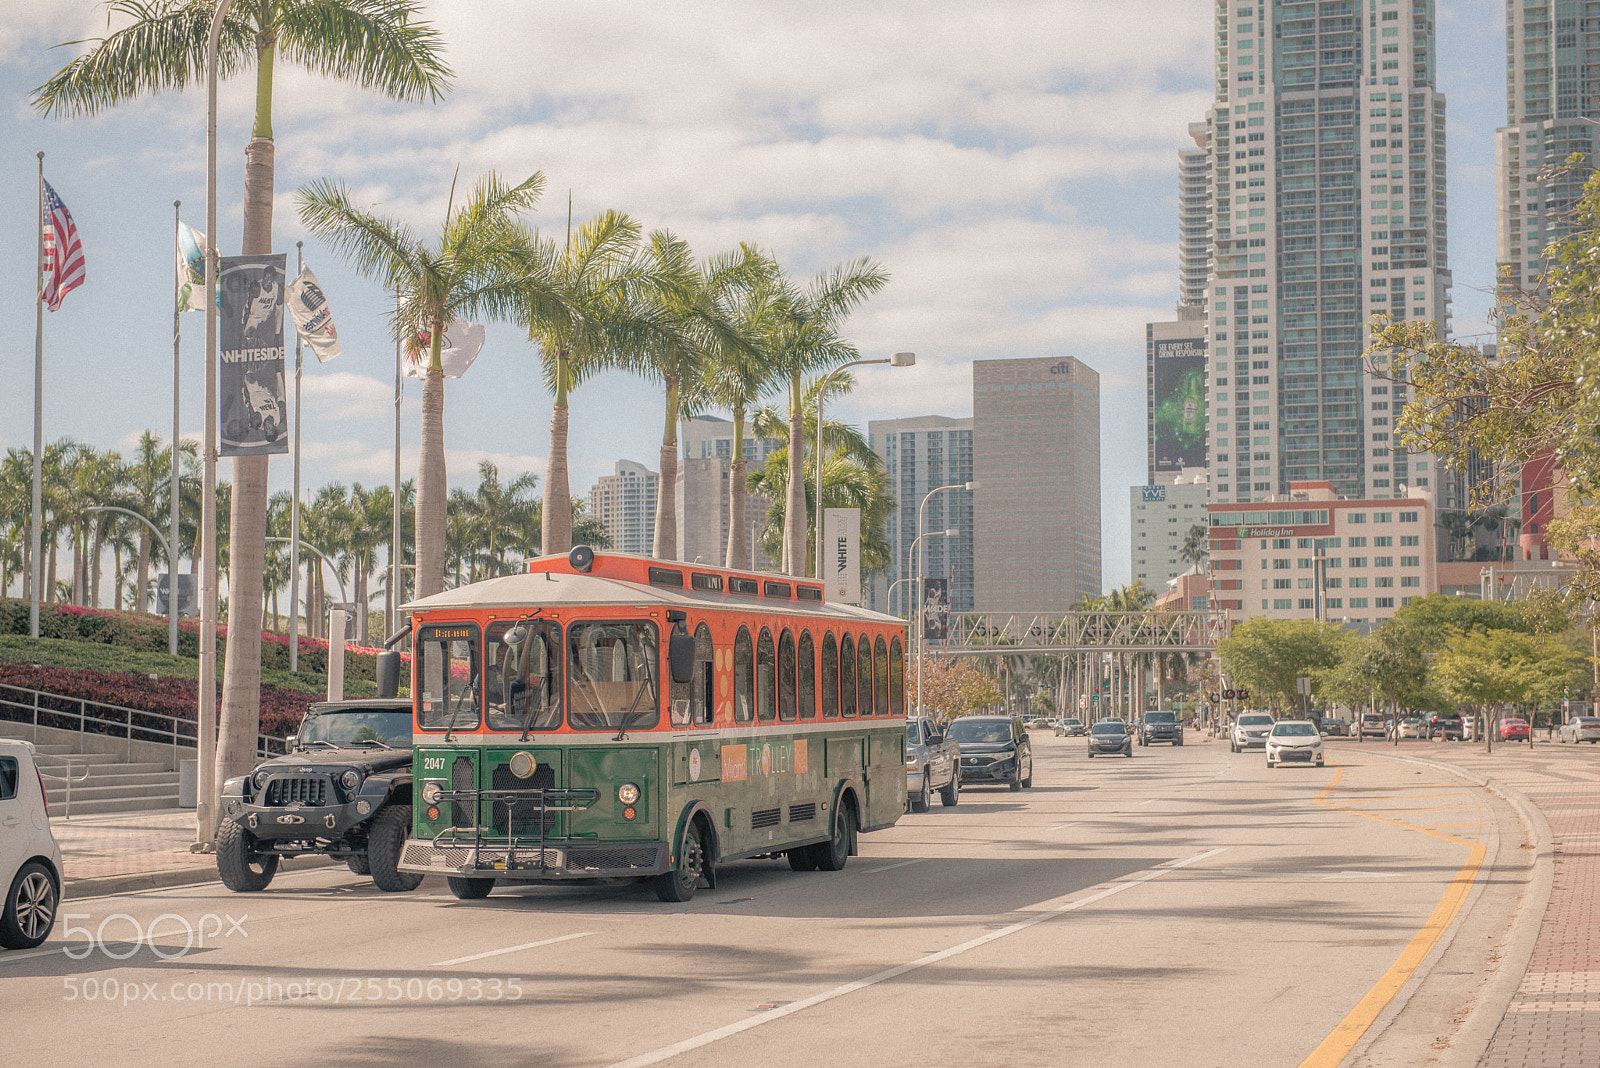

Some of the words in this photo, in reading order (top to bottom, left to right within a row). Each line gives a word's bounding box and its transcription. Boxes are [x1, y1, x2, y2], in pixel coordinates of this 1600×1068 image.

[220, 346, 285, 363] WHITESIDE
[1050, 362, 1069, 374] citi
[1143, 489, 1165, 498] YVE
[1250, 528, 1280, 537] Holiday
[1281, 527, 1294, 536] Inn
[837, 537, 847, 573] WHITE
[924, 604, 948, 613] WADE
[424, 757, 446, 770] 2047
[749, 743, 792, 776] TROLLEY
[299, 766, 313, 774] Jeep
